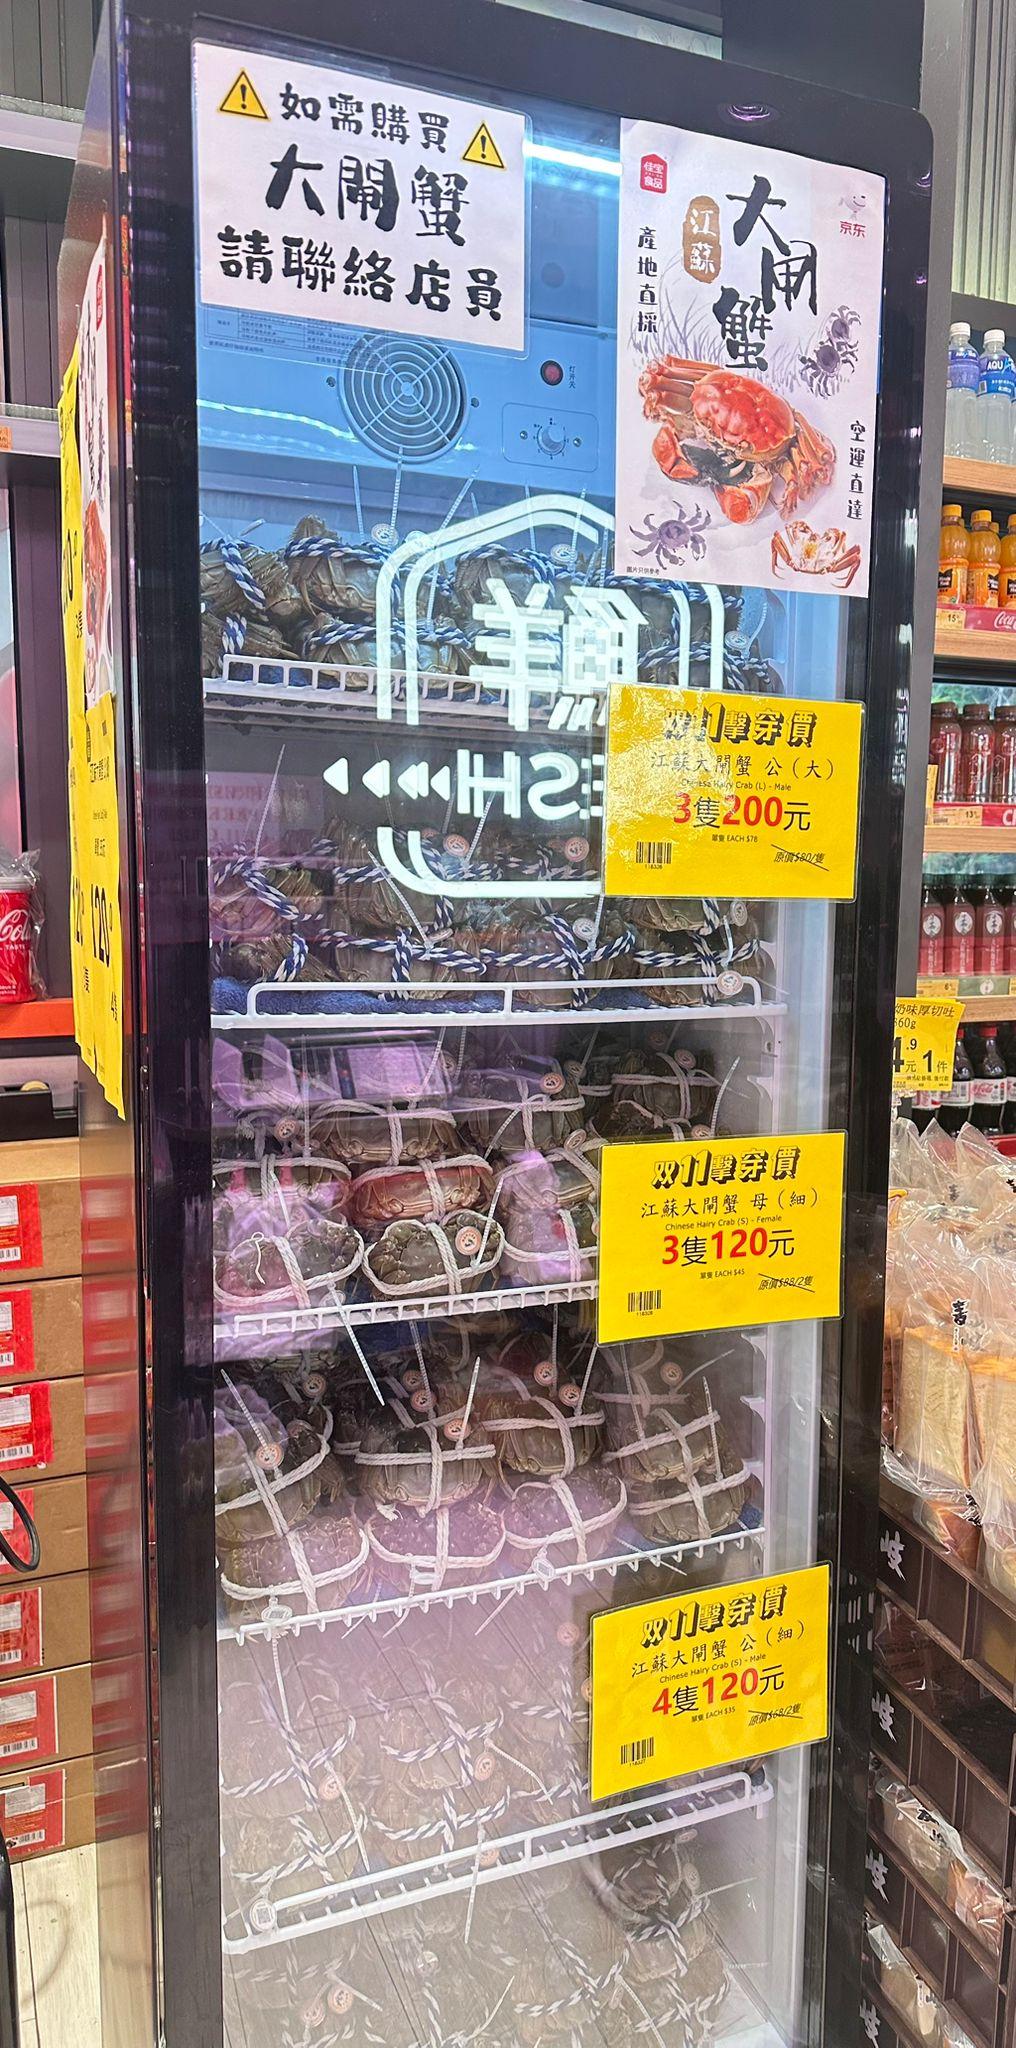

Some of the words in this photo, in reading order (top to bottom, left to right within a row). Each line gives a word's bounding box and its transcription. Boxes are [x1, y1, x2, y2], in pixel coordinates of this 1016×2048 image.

[280, 83, 450, 153] 如需購買
[265, 144, 469, 247] 大閘蟹
[644, 176, 663, 188] 食品
[690, 208, 716, 274] 江蘇
[839, 220, 866, 238] 京东
[217, 225, 502, 321] 請聯絡店員
[736, 781, 753, 790] Crab
[755, 781, 766, 791] (L)
[774, 783, 792, 792] Male
[726, 834, 744, 843] EACH
[746, 835, 758, 843] $78
[651, 1145, 801, 1190] 双11擊穿價
[641, 1194, 738, 1219] 江蘇大閘蟹
[665, 1221, 695, 1231] Chinese
[697, 1219, 716, 1231] Hairy
[718, 1218, 735, 1228] Crab
[737, 1216, 749, 1227] (S)
[756, 1214, 782, 1224] Female
[661, 1227, 795, 1267] 3隻120元
[715, 1270, 732, 1279] EACH
[734, 1268, 745, 1277] $45
[640, 1583, 787, 1649] 双11擊穿價
[631, 1640, 727, 1678] 江蘇大閘蟹
[659, 1671, 688, 1684] Chinese
[690, 1666, 710, 1679] Hairy
[711, 1662, 729, 1673] Crab
[730, 1658, 742, 1669] (S)
[749, 1652, 766, 1663] Male
[652, 1664, 785, 1717] 4隻120元
[705, 1710, 723, 1720] EACH
[724, 1706, 736, 1716] $35
